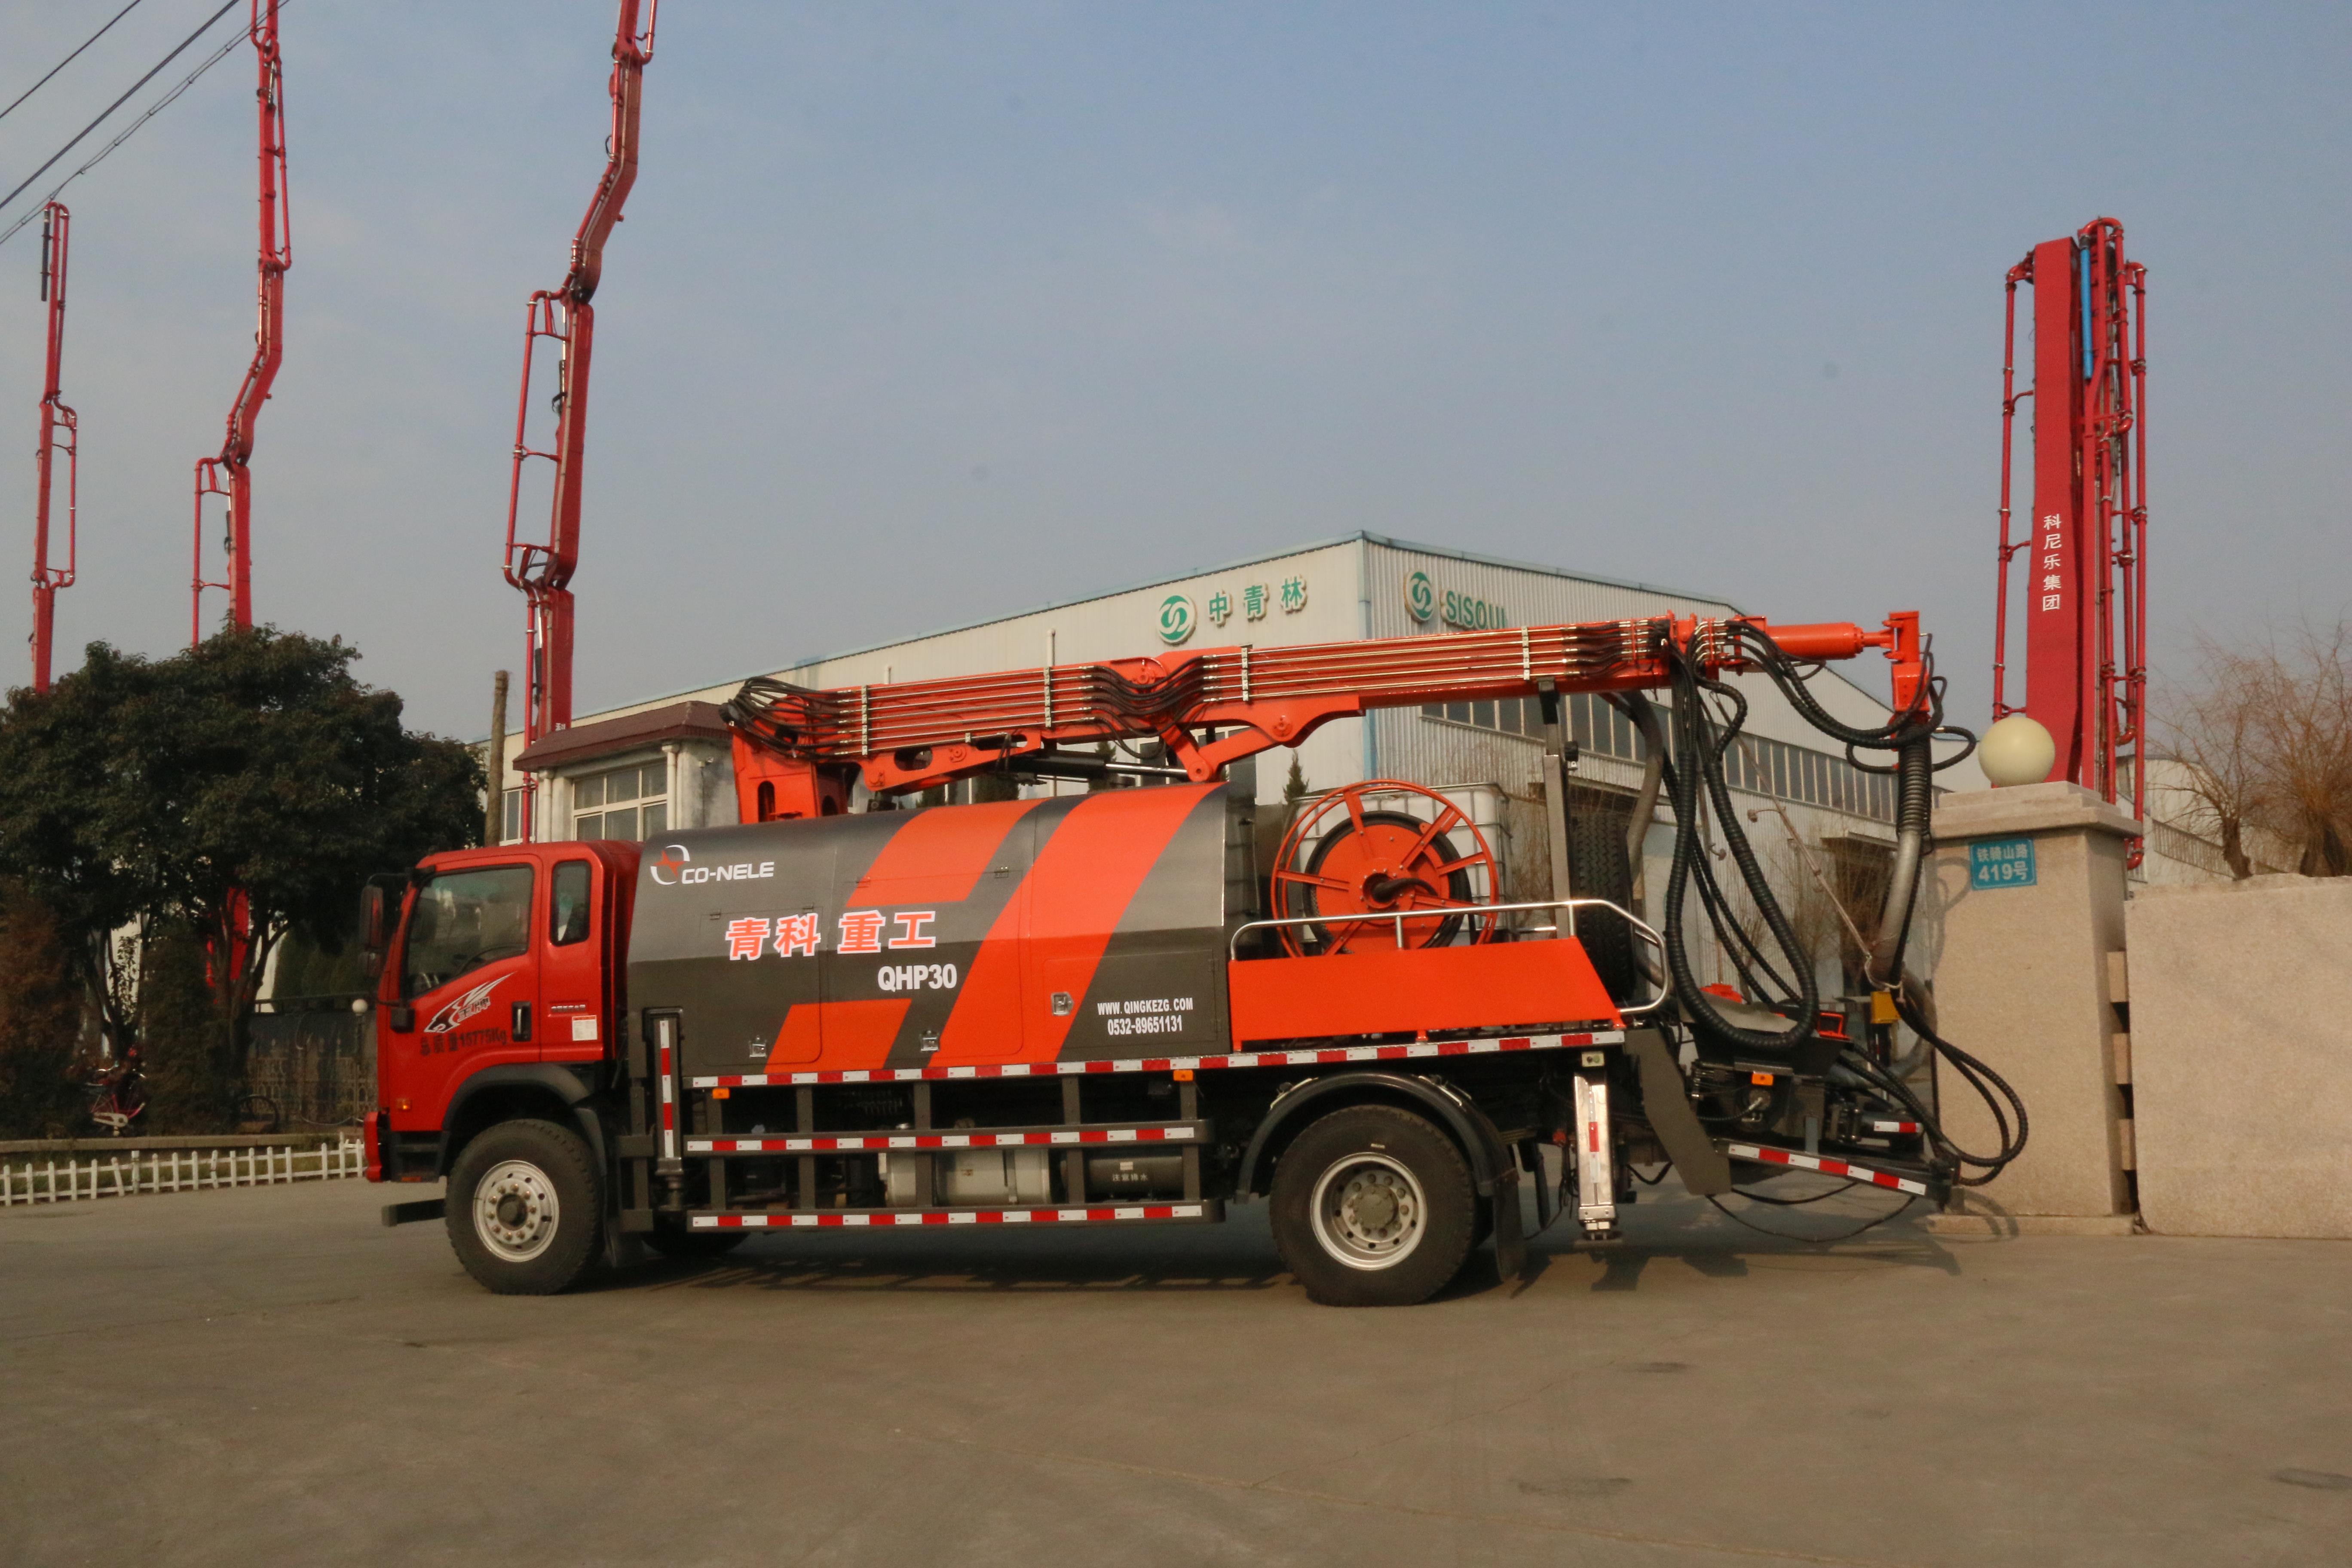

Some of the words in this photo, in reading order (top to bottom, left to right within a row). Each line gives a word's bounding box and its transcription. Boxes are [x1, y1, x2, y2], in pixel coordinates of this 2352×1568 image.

[2043, 513, 2062, 612] 科尼乐集团
[1208, 576, 1303, 622] 中青林
[682, 862, 775, 884] CO-NELE
[1978, 861, 2029, 882] 419号
[725, 910, 936, 961] 青科重工
[878, 963, 957, 992] QHP30
[1108, 1015, 1183, 1035] 0532-89651131
